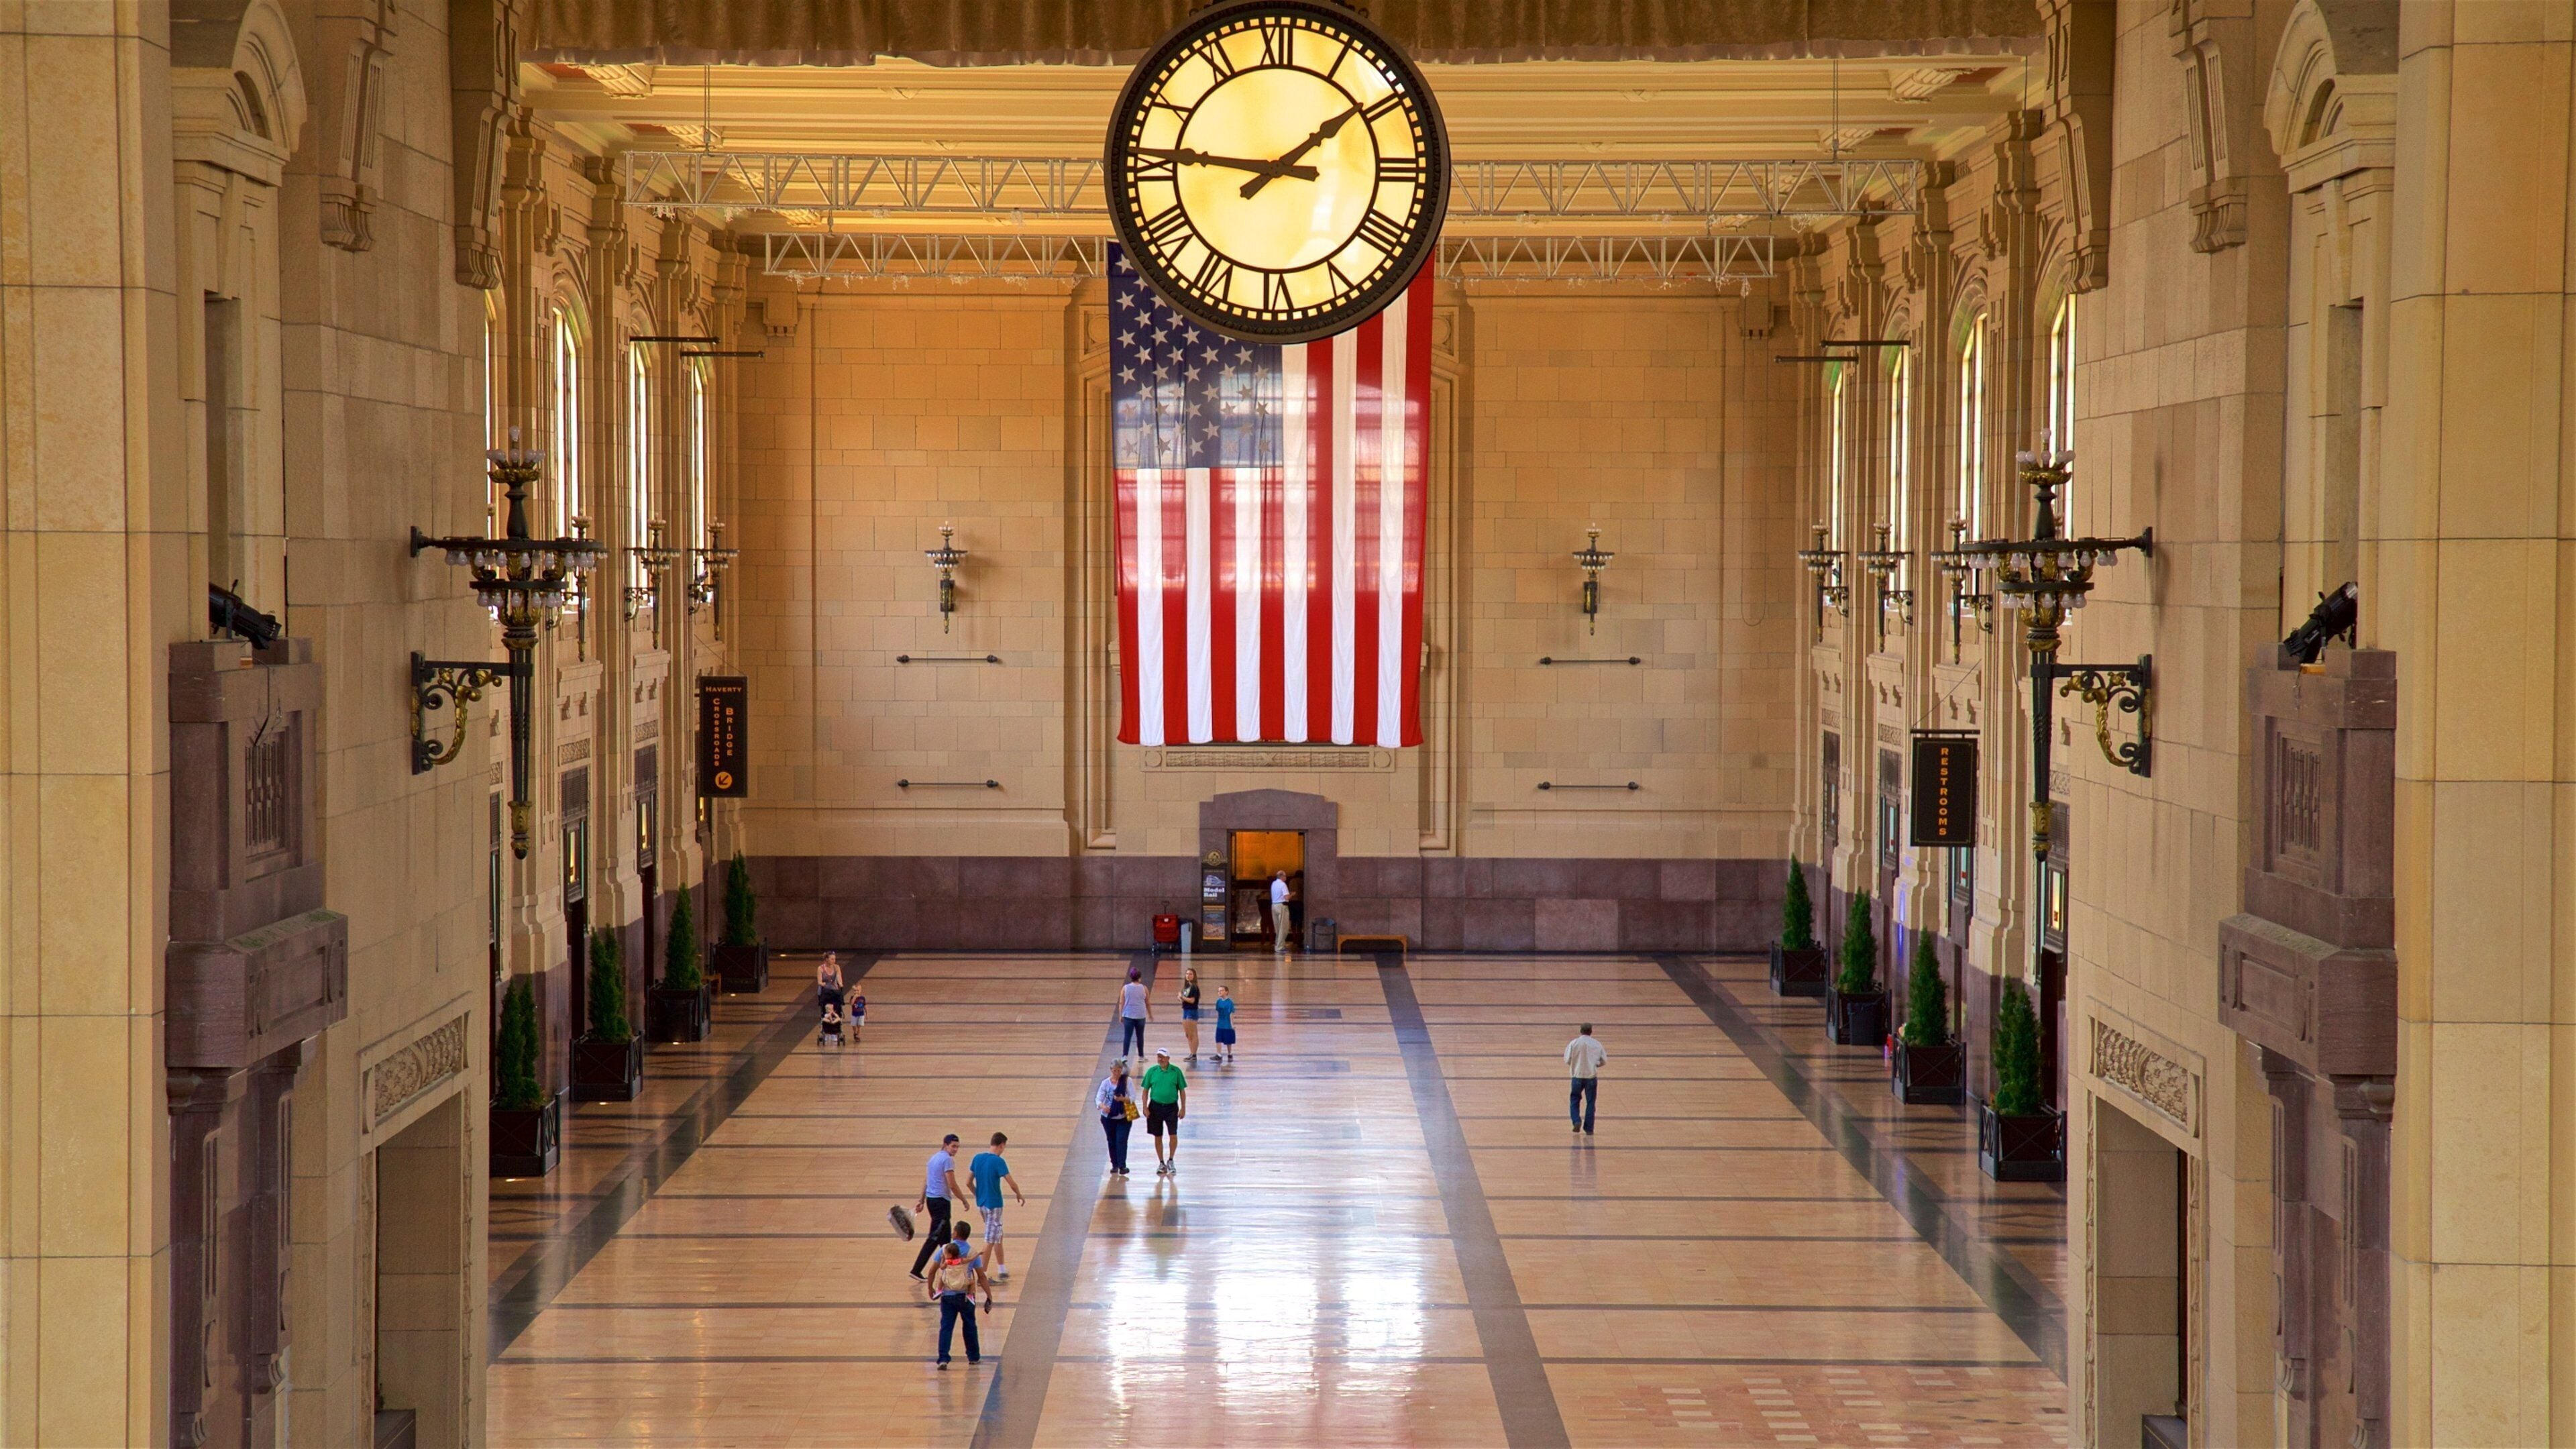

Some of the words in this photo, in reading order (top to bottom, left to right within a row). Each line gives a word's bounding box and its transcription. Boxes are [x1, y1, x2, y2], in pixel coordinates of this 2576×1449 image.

[1197, 40, 1234, 85] XI
[1261, 26, 1293, 68] XII
[1328, 40, 1352, 79] I
[1152, 93, 1192, 122] X
[1362, 93, 1403, 123] II
[1379, 158, 1417, 181] III
[1146, 208, 1194, 263] VIII
[1194, 251, 1233, 301] VII
[1264, 271, 1294, 310] VI
[1327, 260, 1355, 298] V
[726, 708, 734, 756] BRIDGE
[1939, 748, 1949, 835] RESTROOMS
